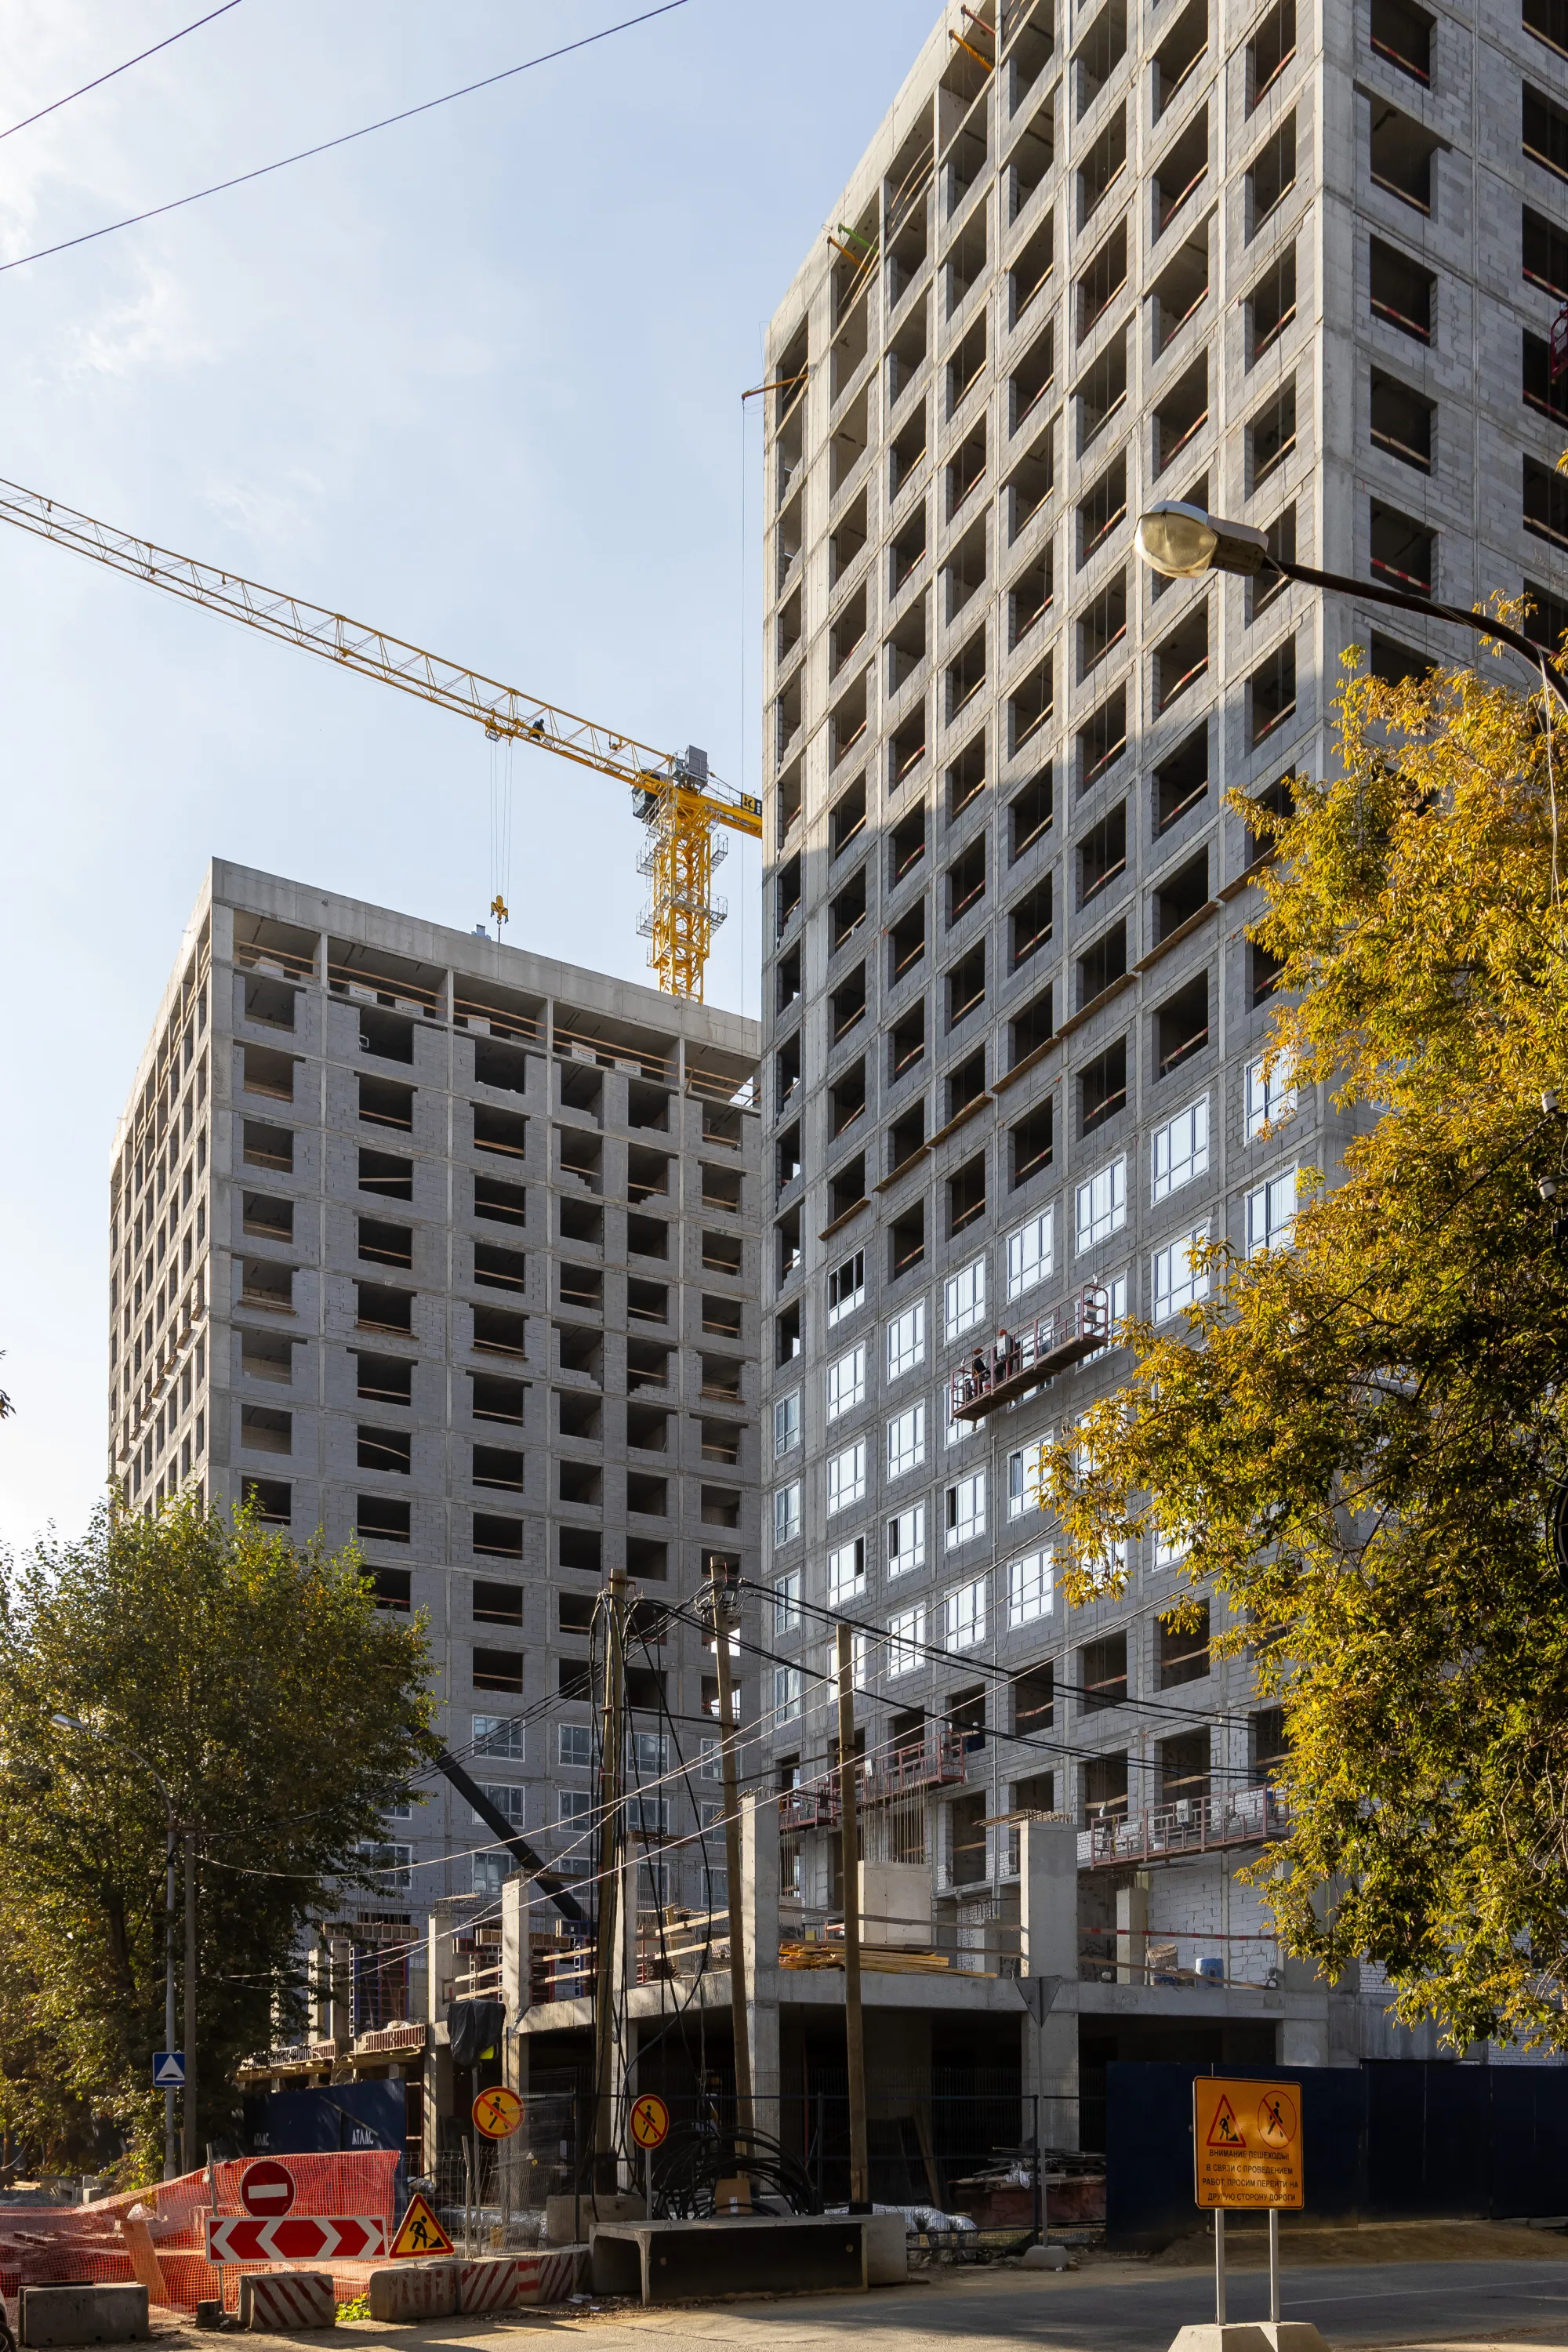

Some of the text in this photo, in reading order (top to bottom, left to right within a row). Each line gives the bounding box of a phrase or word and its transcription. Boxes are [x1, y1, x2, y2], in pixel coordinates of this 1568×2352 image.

[1209, 2149, 1247, 2158] ВНИМАНИЕ
[1213, 2164, 1236, 2172] СВЯЗИ
[1243, 2165, 1293, 2175] ПРОВЕДЕНИЕМ
[1227, 2179, 1255, 2187] ПРОСИМ
[1257, 2179, 1287, 2188] ПЕРЕЙТИ
[1208, 2193, 1296, 2202] ДРУГУЮ СТОРОНУ ДОРОГИ
